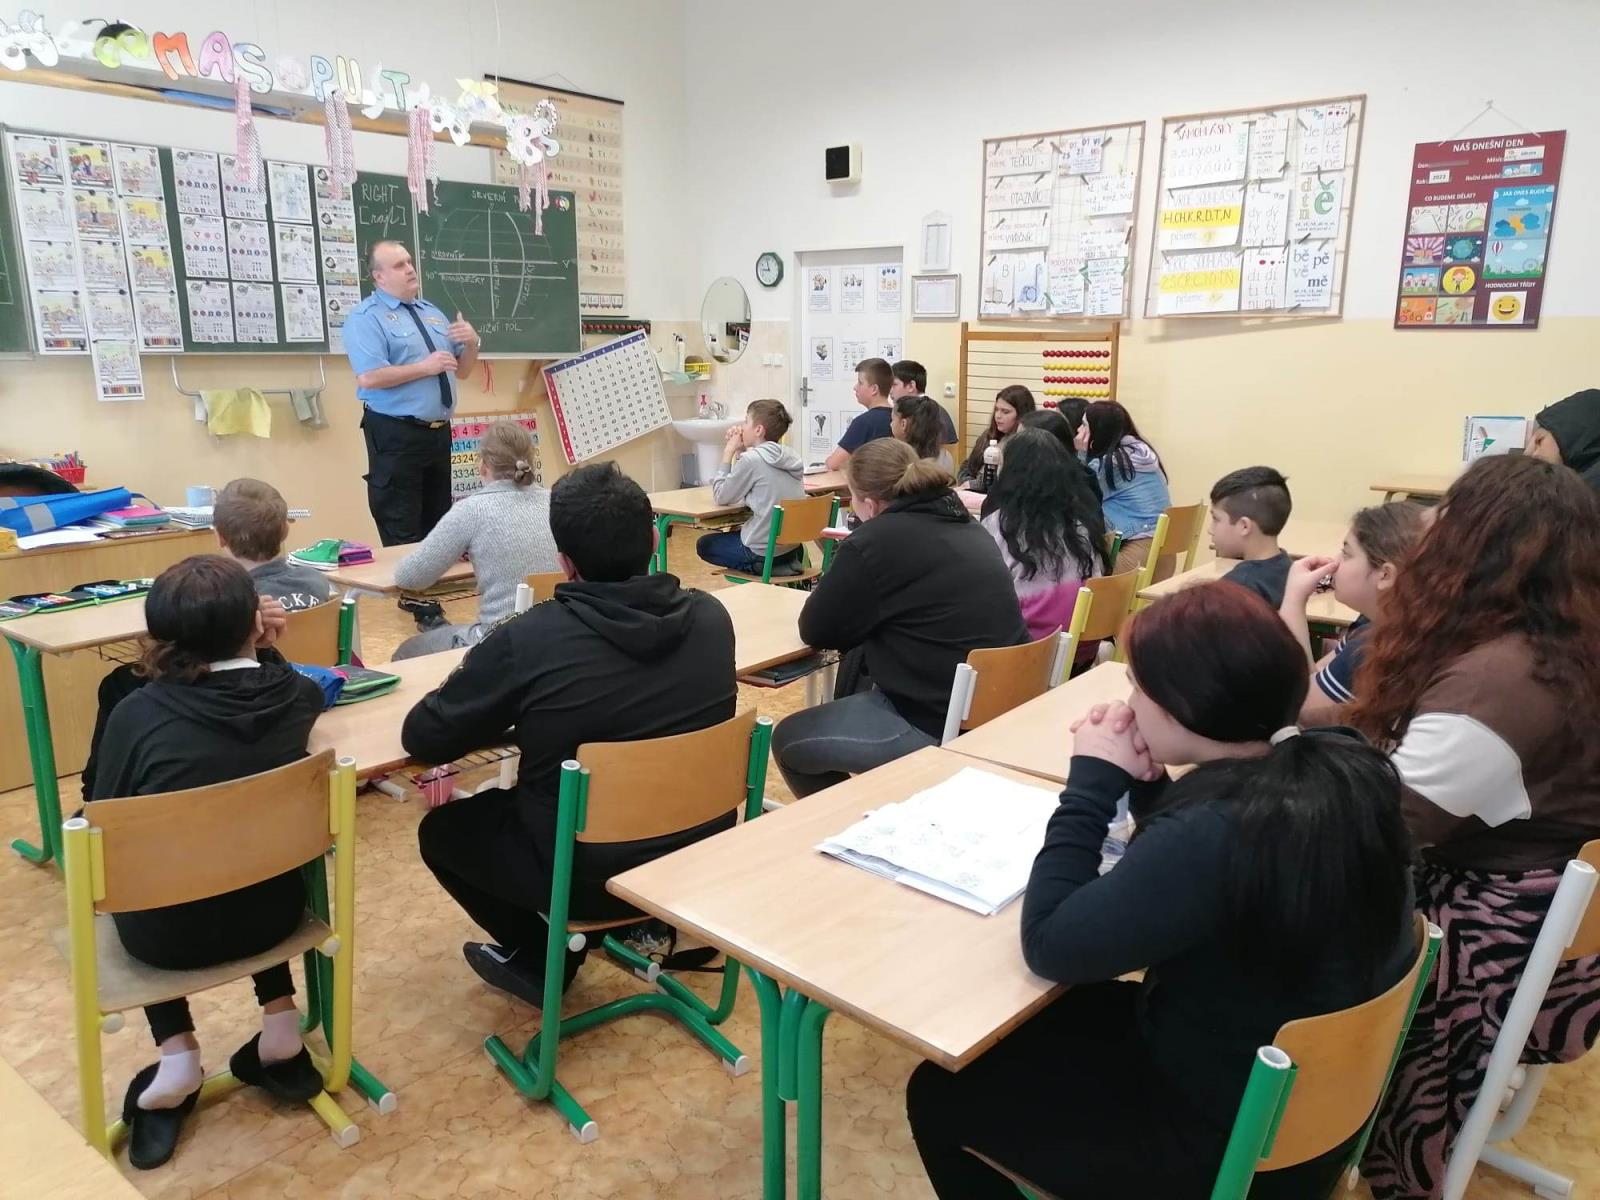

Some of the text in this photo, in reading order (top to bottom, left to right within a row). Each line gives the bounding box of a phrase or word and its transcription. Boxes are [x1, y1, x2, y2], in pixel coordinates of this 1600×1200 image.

[1453, 138, 1524, 152] NÁŠ DNEŠNÍ DEN
[362, 182, 398, 204] RIGHT
[1313, 252, 1330, 269] pě
[1308, 275, 1328, 288] mě
[463, 427, 468, 436] 4
[474, 425, 480, 434] 5
[527, 420, 536, 430] 10
[462, 440, 471, 450] 14
[452, 454, 462, 464] 23
[462, 453, 474, 463] 24
[453, 470, 462, 479] 33
[463, 468, 474, 478] 34
[454, 483, 465, 492] 43
[466, 481, 477, 491] 44
